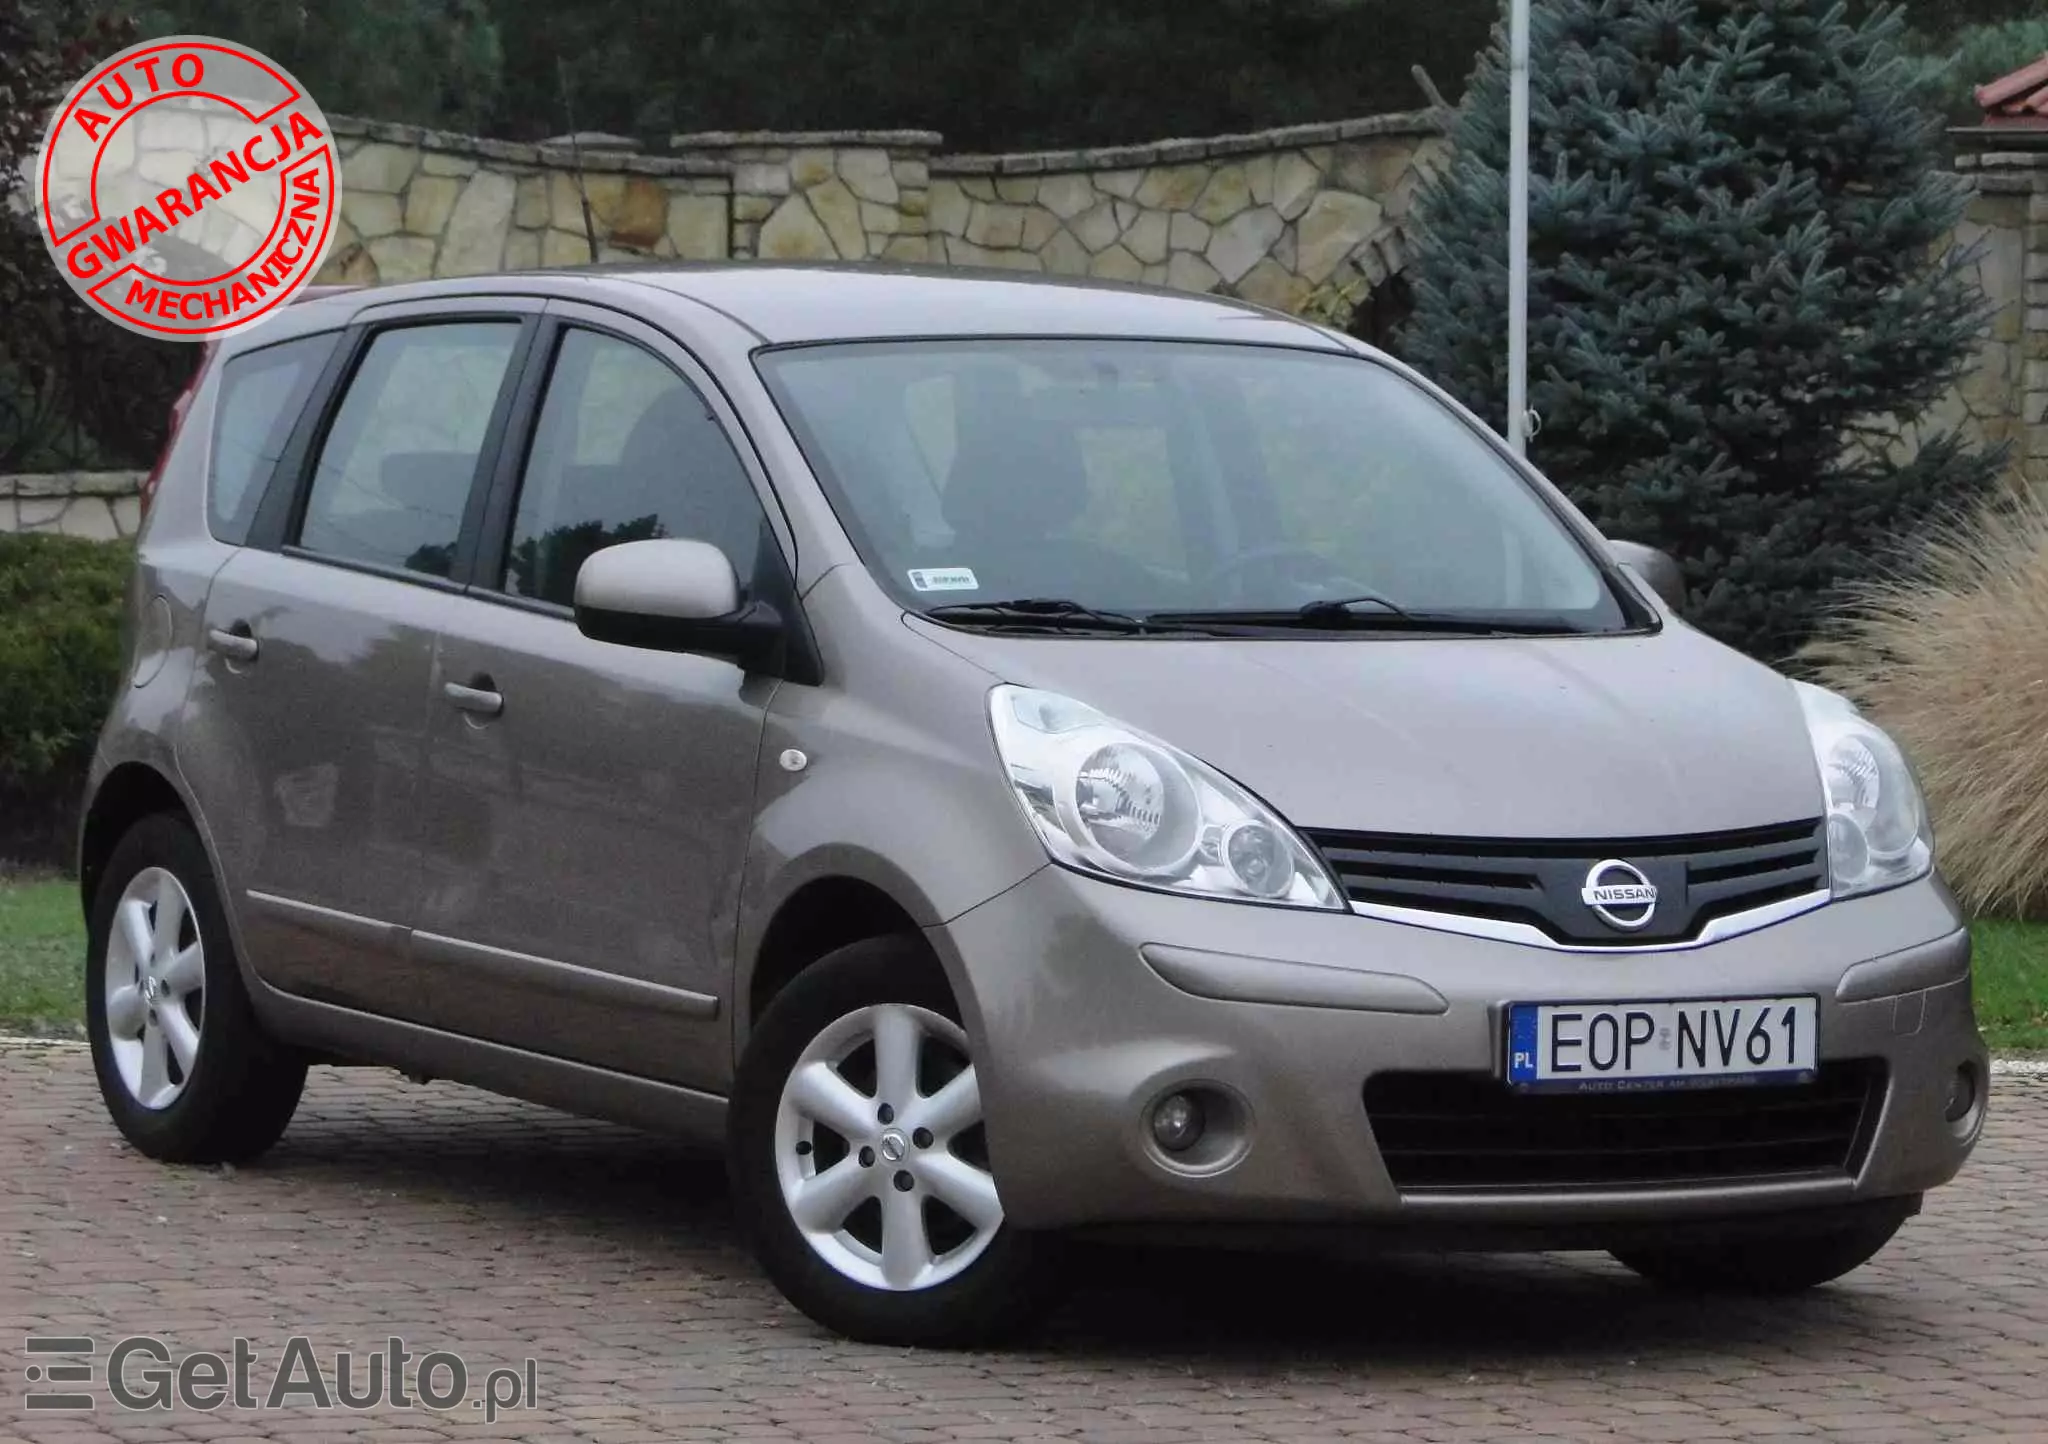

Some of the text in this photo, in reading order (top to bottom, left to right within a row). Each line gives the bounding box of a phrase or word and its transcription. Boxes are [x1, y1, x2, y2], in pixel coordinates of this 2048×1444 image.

[1593, 887, 1655, 901] NISSAN
[1551, 1006, 1796, 1072] EOP NV61
[1514, 1052, 1533, 1069] PL
